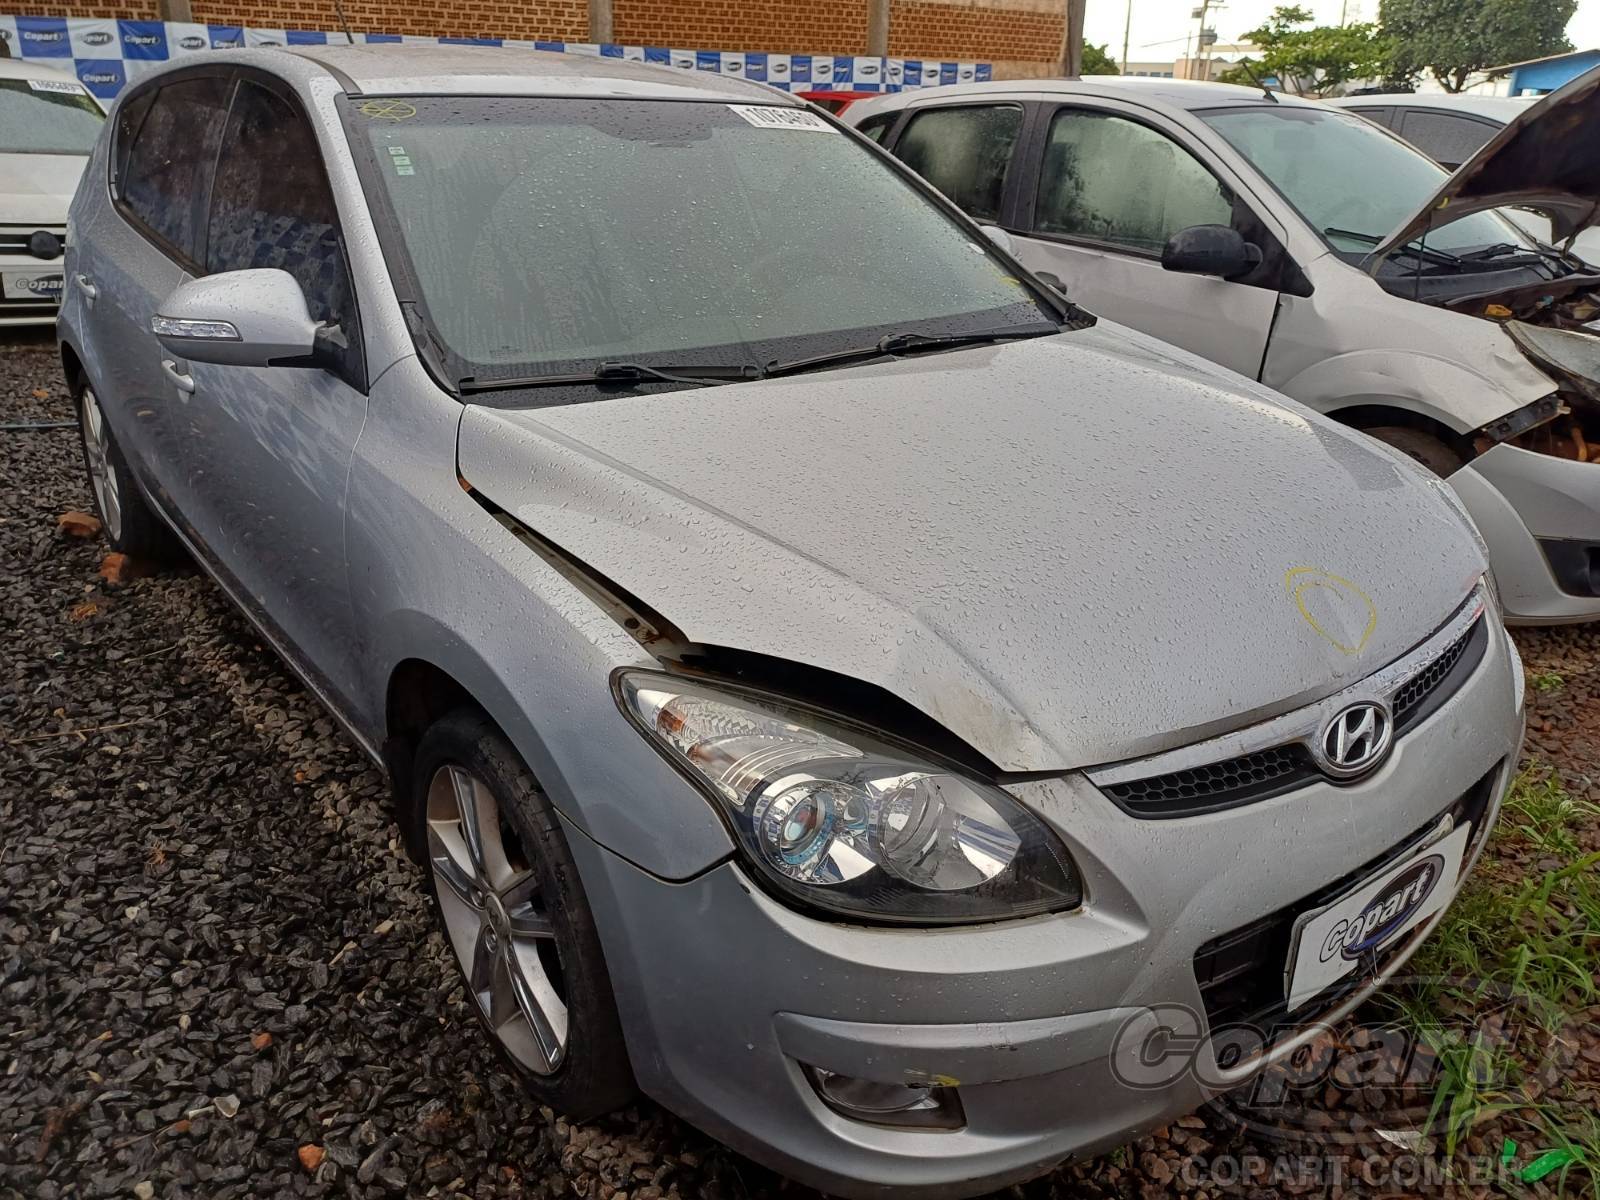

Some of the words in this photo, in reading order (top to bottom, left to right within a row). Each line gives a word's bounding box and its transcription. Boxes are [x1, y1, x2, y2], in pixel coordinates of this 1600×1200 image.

[24, 31, 59, 41] Copart
[124, 36, 156, 45] Copart
[83, 74, 115, 84] Copart
[16, 279, 64, 291] Copar
[1319, 861, 1433, 963] Copart
